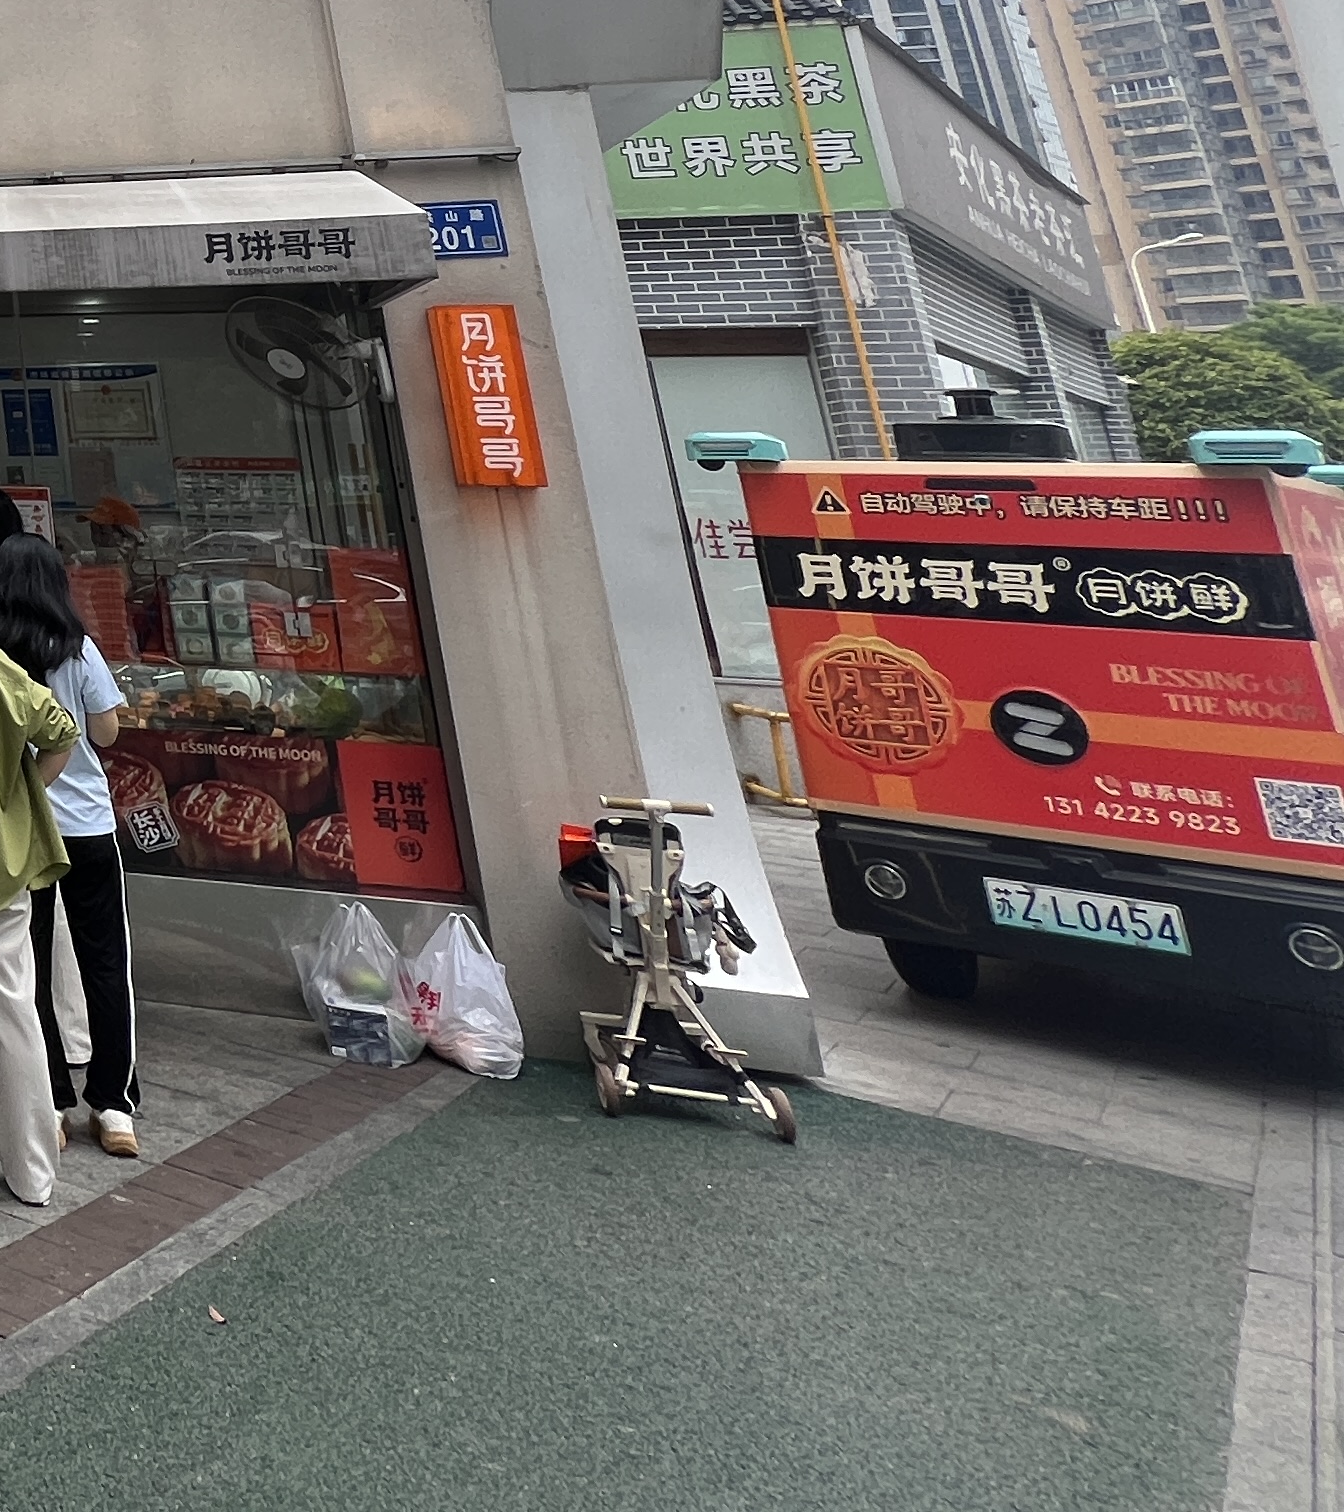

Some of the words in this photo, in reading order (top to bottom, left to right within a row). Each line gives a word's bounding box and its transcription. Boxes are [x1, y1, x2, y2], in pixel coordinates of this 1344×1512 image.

[621, 128, 862, 179] 世界共享
[204, 227, 356, 263] 月饼哥哥
[429, 225, 475, 250] 201
[272, 266, 286, 275] OF
[287, 265, 305, 274] THE
[307, 263, 338, 273] MOON
[460, 312, 524, 478] 月饼哥哥
[796, 552, 1056, 614] 月饼哥哥
[1088, 576, 1235, 612] 月饼鲜
[1108, 662, 1259, 693] BLESSING
[1163, 692, 1221, 715] THE
[165, 740, 227, 757] BLESSING
[229, 744, 249, 758] OF
[250, 746, 277, 761] THE
[278, 747, 322, 763] MOON
[372, 780, 425, 807] 月饼
[133, 810, 160, 846] 长沙
[373, 807, 430, 834] 哥哥
[1043, 795, 1084, 816] 131
[1094, 800, 1161, 826] 4223
[1169, 809, 1241, 836] 9823
